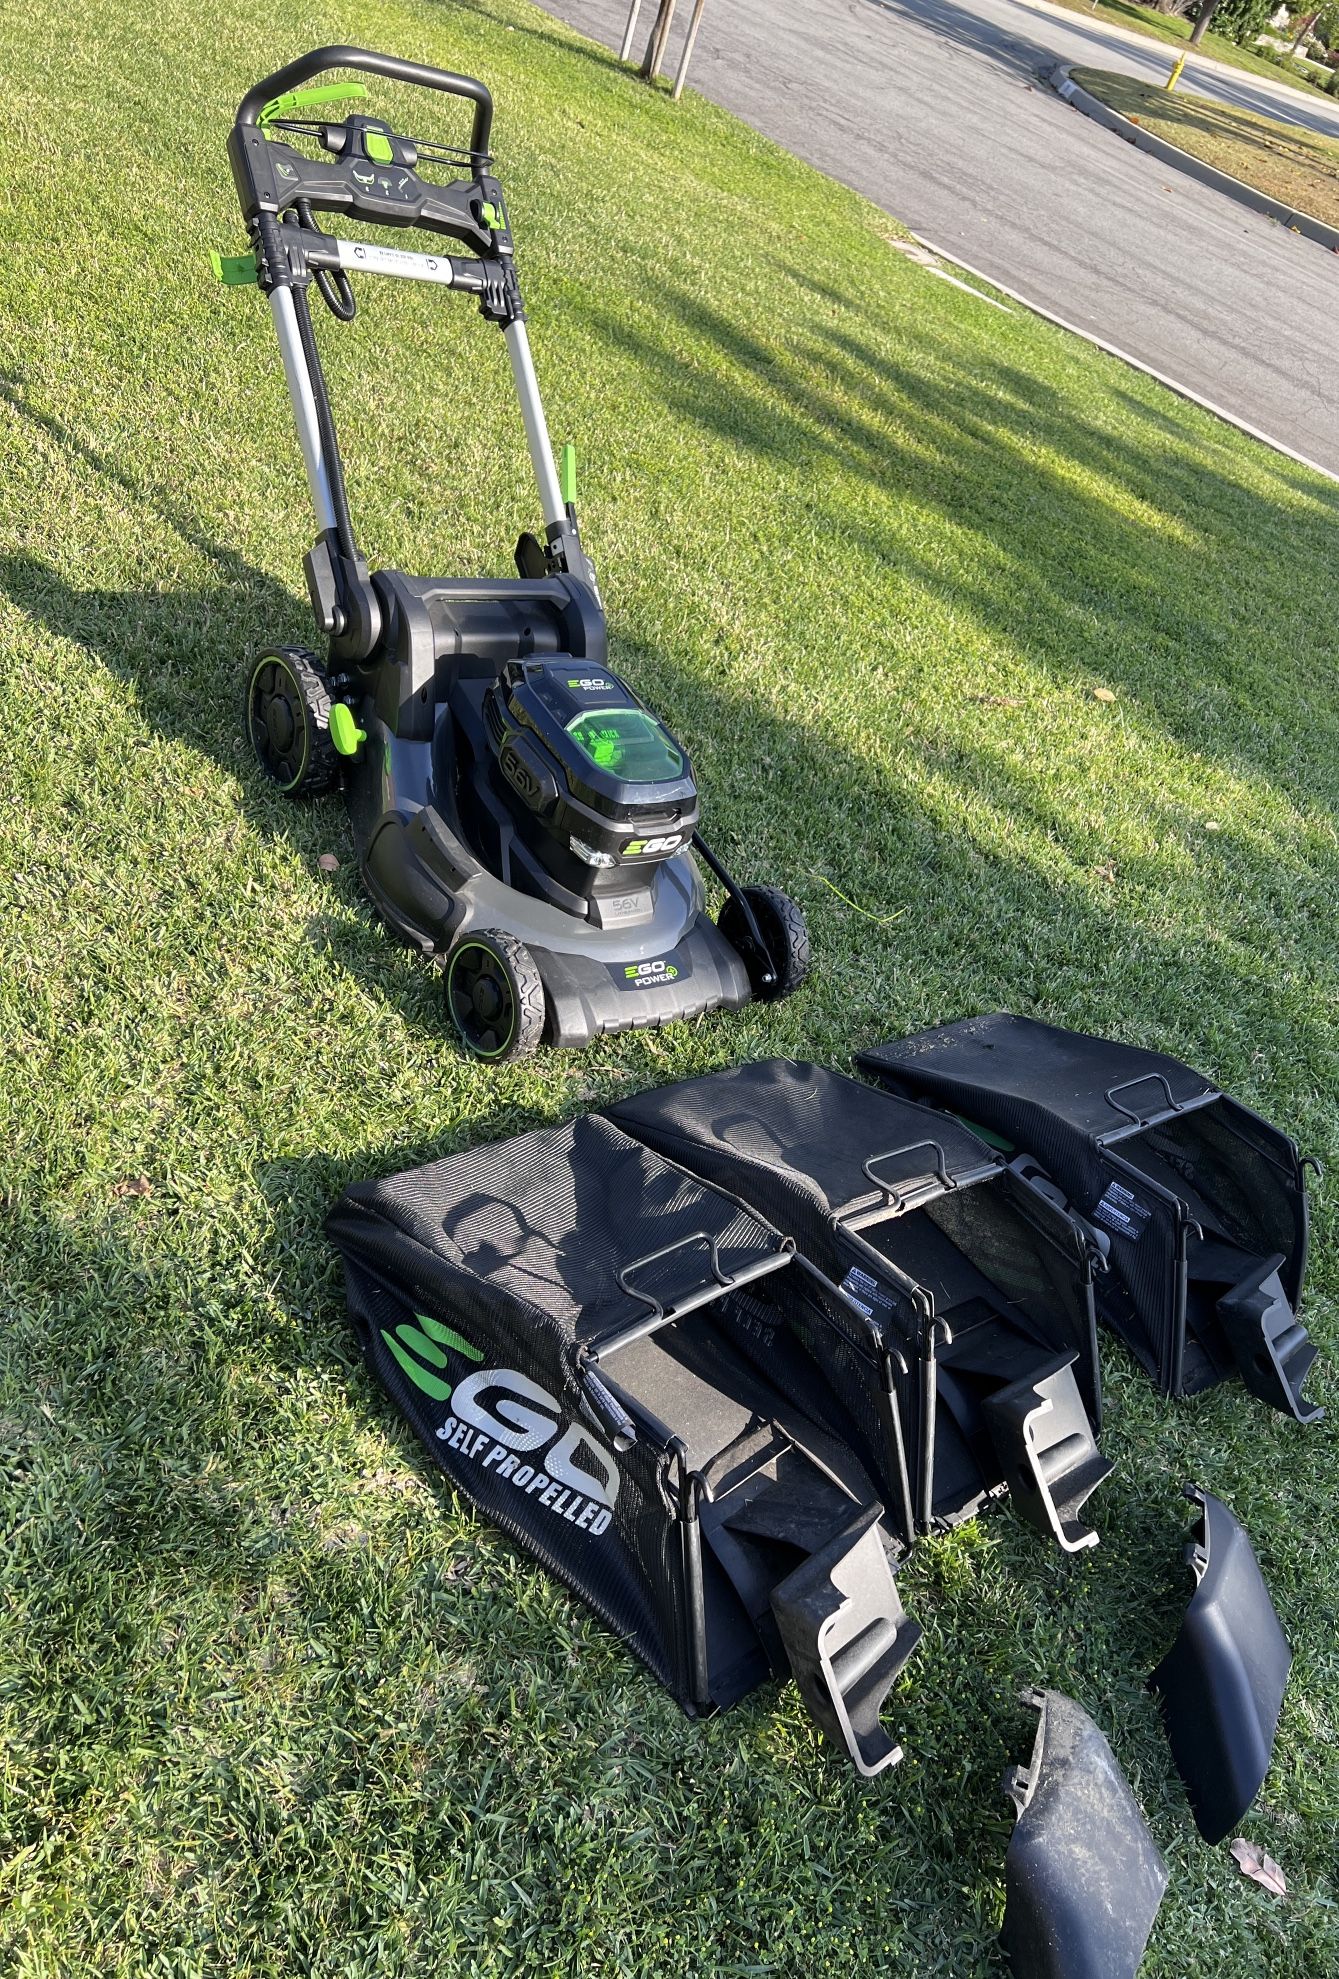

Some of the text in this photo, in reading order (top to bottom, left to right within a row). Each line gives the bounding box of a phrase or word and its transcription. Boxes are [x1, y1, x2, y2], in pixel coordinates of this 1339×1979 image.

[567, 678, 605, 688] EGO
[503, 750, 541, 798] 56V
[622, 834, 683, 855] EGO
[612, 897, 639, 911] 56V
[624, 961, 665, 978] EGO
[634, 972, 675, 987] POWER
[380, 1312, 620, 1511] EGO
[436, 1416, 613, 1536] SELF PROPELLED
